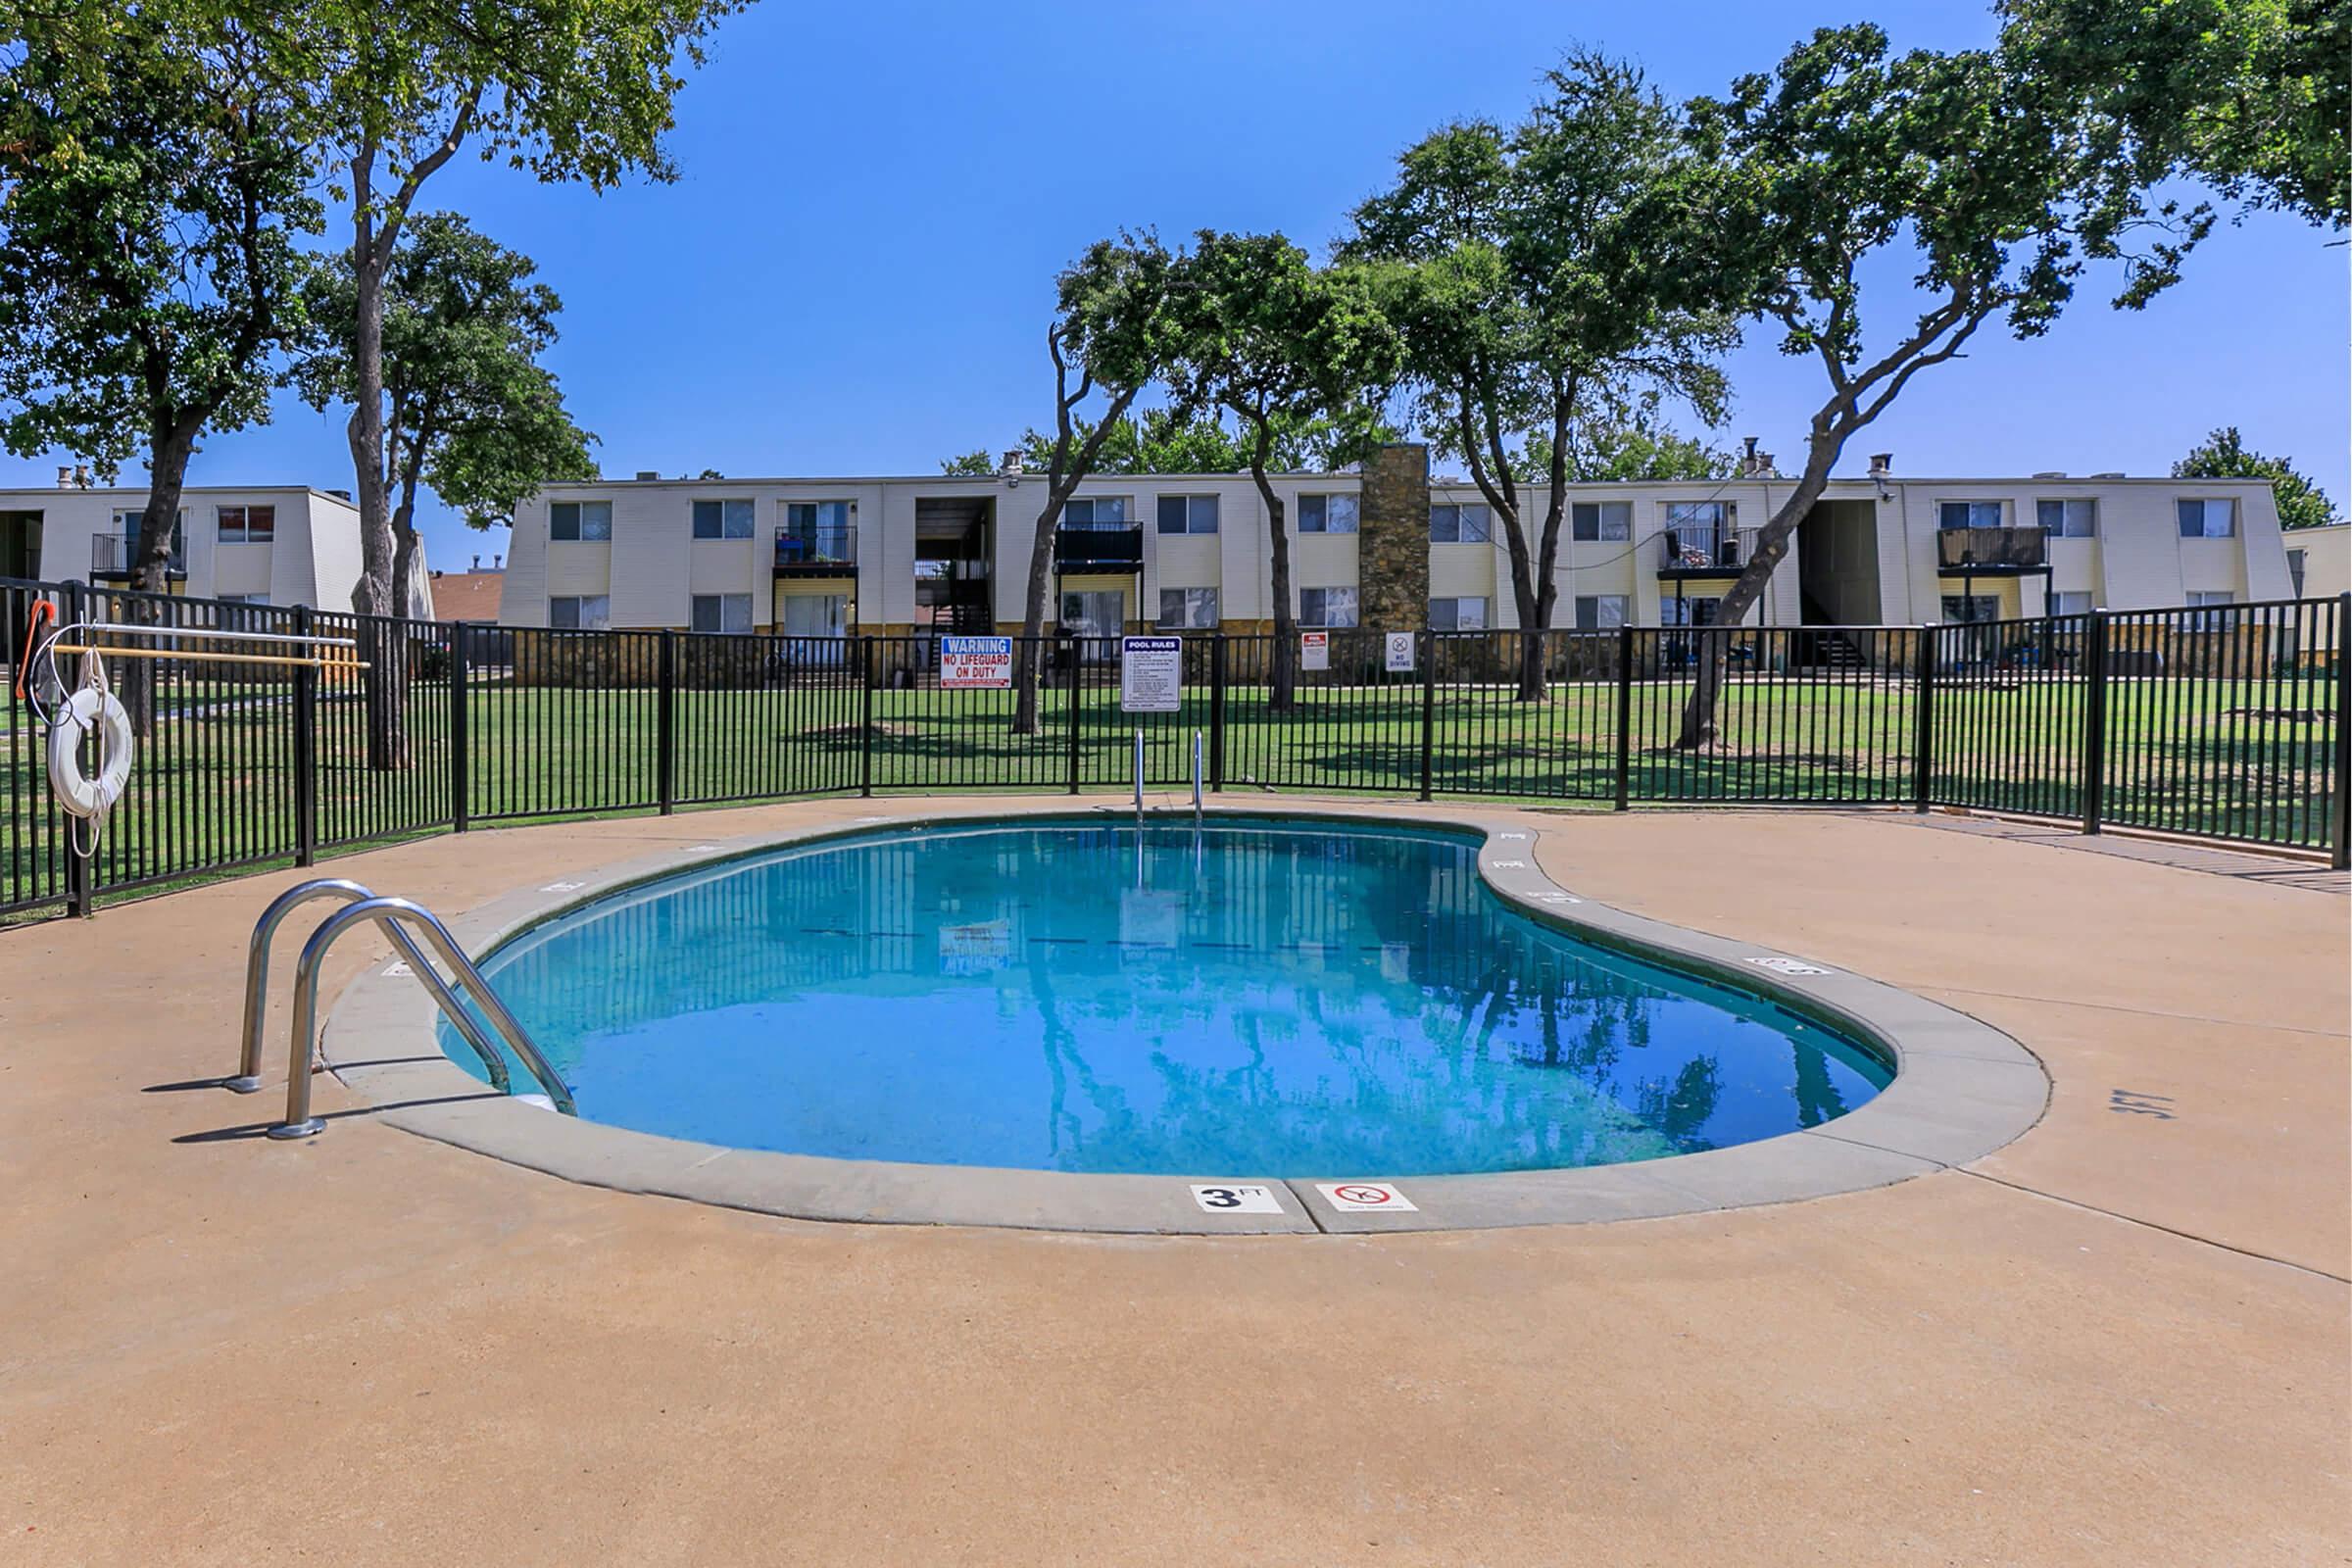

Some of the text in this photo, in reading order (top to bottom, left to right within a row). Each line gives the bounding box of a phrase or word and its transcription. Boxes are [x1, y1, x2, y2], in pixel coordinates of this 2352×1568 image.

[948, 639, 1006, 653] WARNING
[944, 655, 1009, 665] NO LIFEGUARD
[956, 667, 997, 678] ON DUTY
[1201, 1189, 1240, 1207] 3
